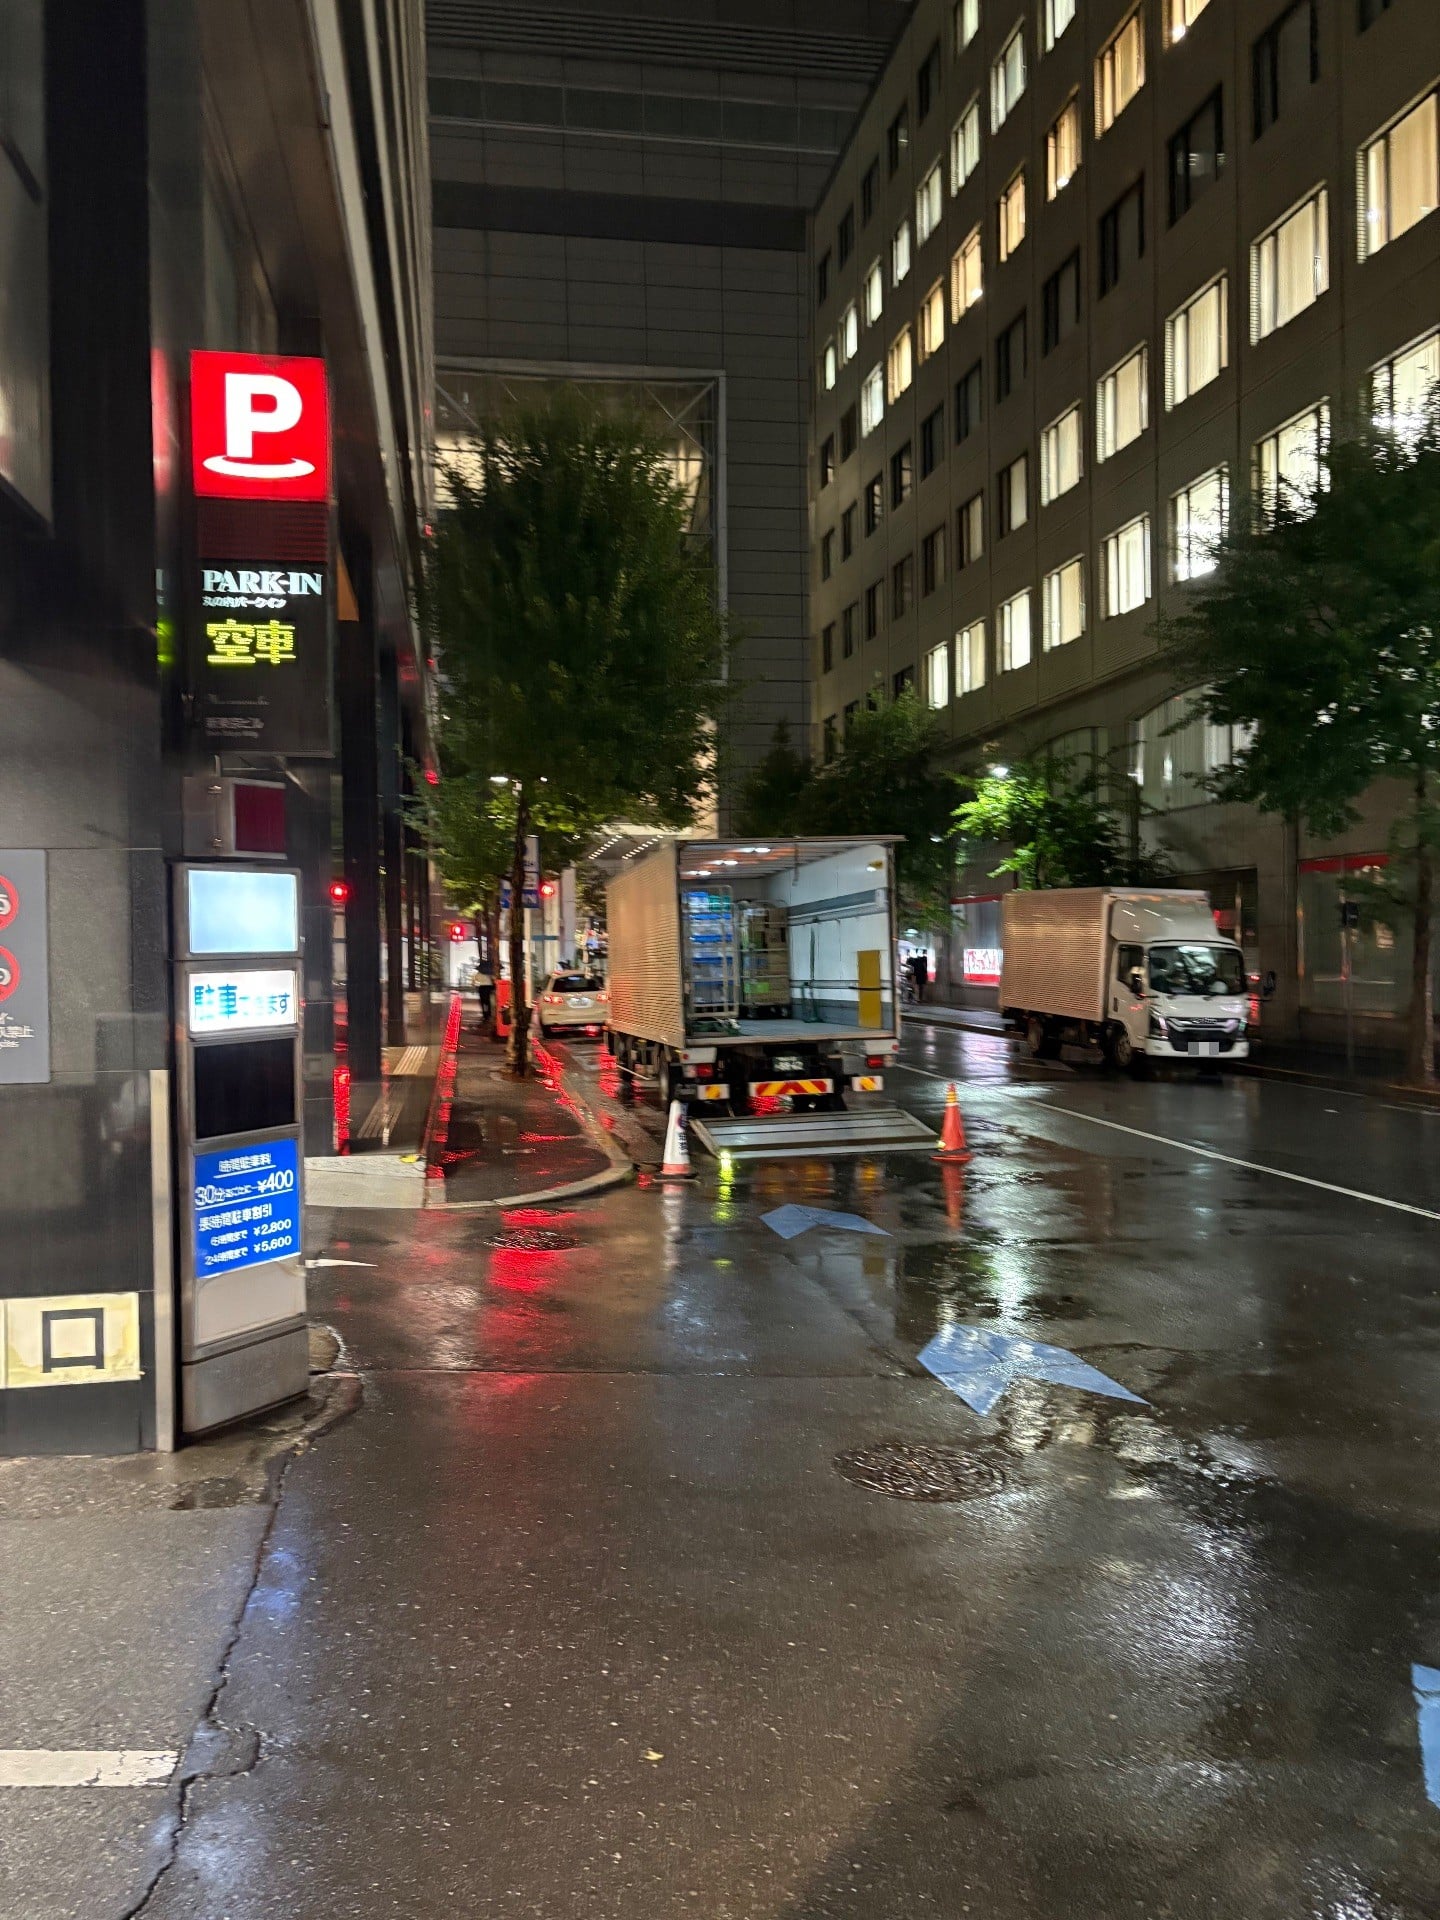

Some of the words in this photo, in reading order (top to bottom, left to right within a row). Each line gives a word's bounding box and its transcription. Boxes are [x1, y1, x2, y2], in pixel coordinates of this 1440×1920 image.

[224, 372, 303, 458] P
[201, 569, 323, 595] PARK-IN
[206, 618, 297, 665] 空車
[257, 1169, 294, 1193] ¥400
